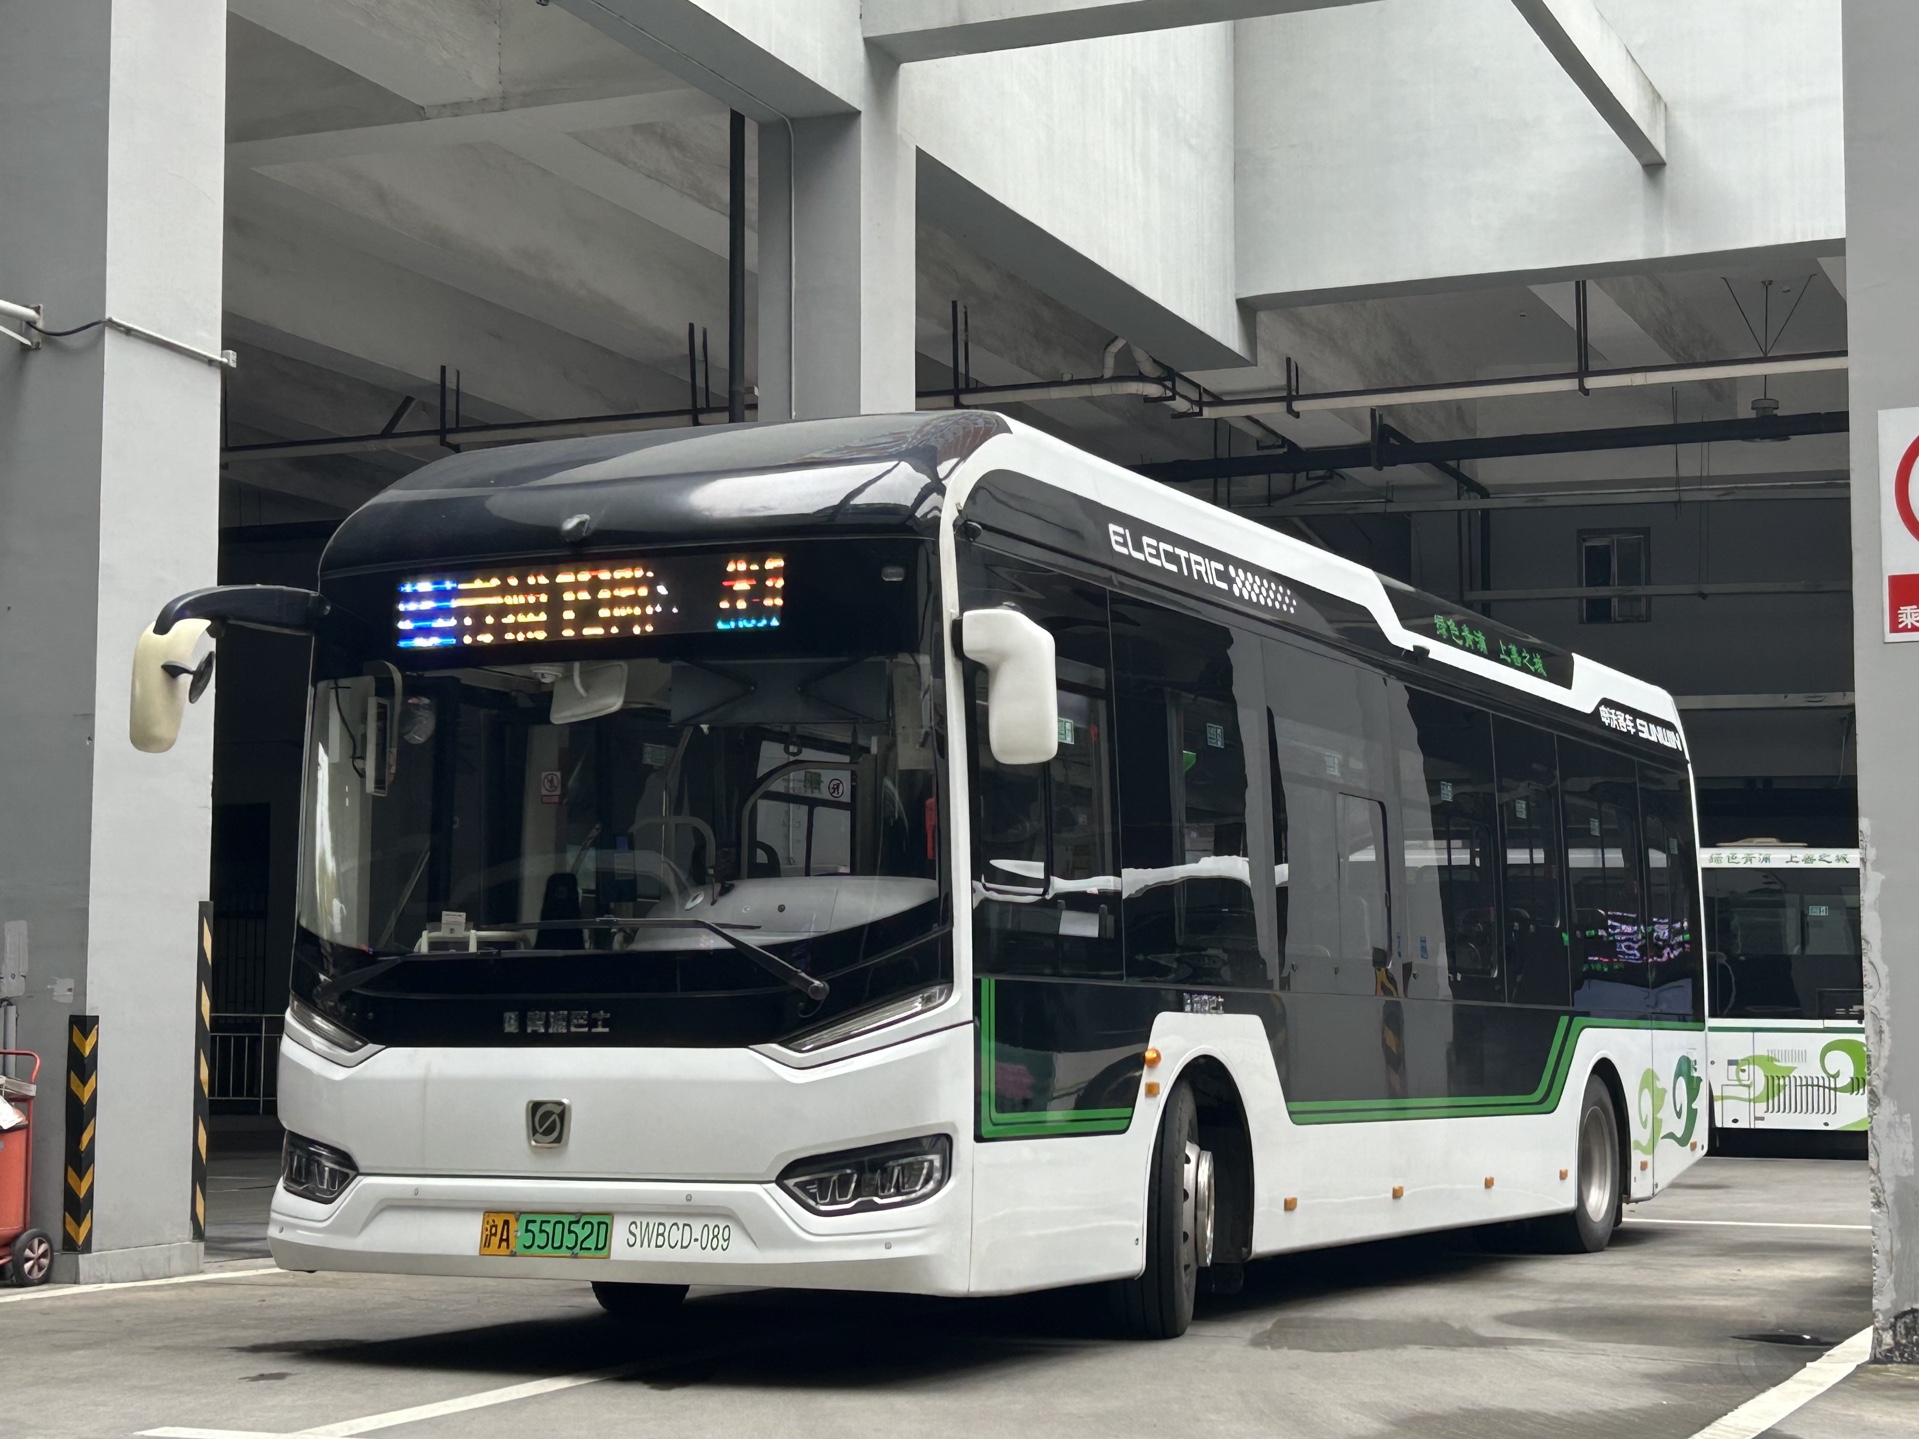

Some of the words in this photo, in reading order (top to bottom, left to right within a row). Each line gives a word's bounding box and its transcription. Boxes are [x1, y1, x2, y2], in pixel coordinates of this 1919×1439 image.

[1108, 523, 1229, 591] ELECTRIC
[1897, 605, 1919, 629] 乘
[1636, 718, 1683, 752] SUNWIN
[626, 1220, 732, 1252] SWBCD-089
